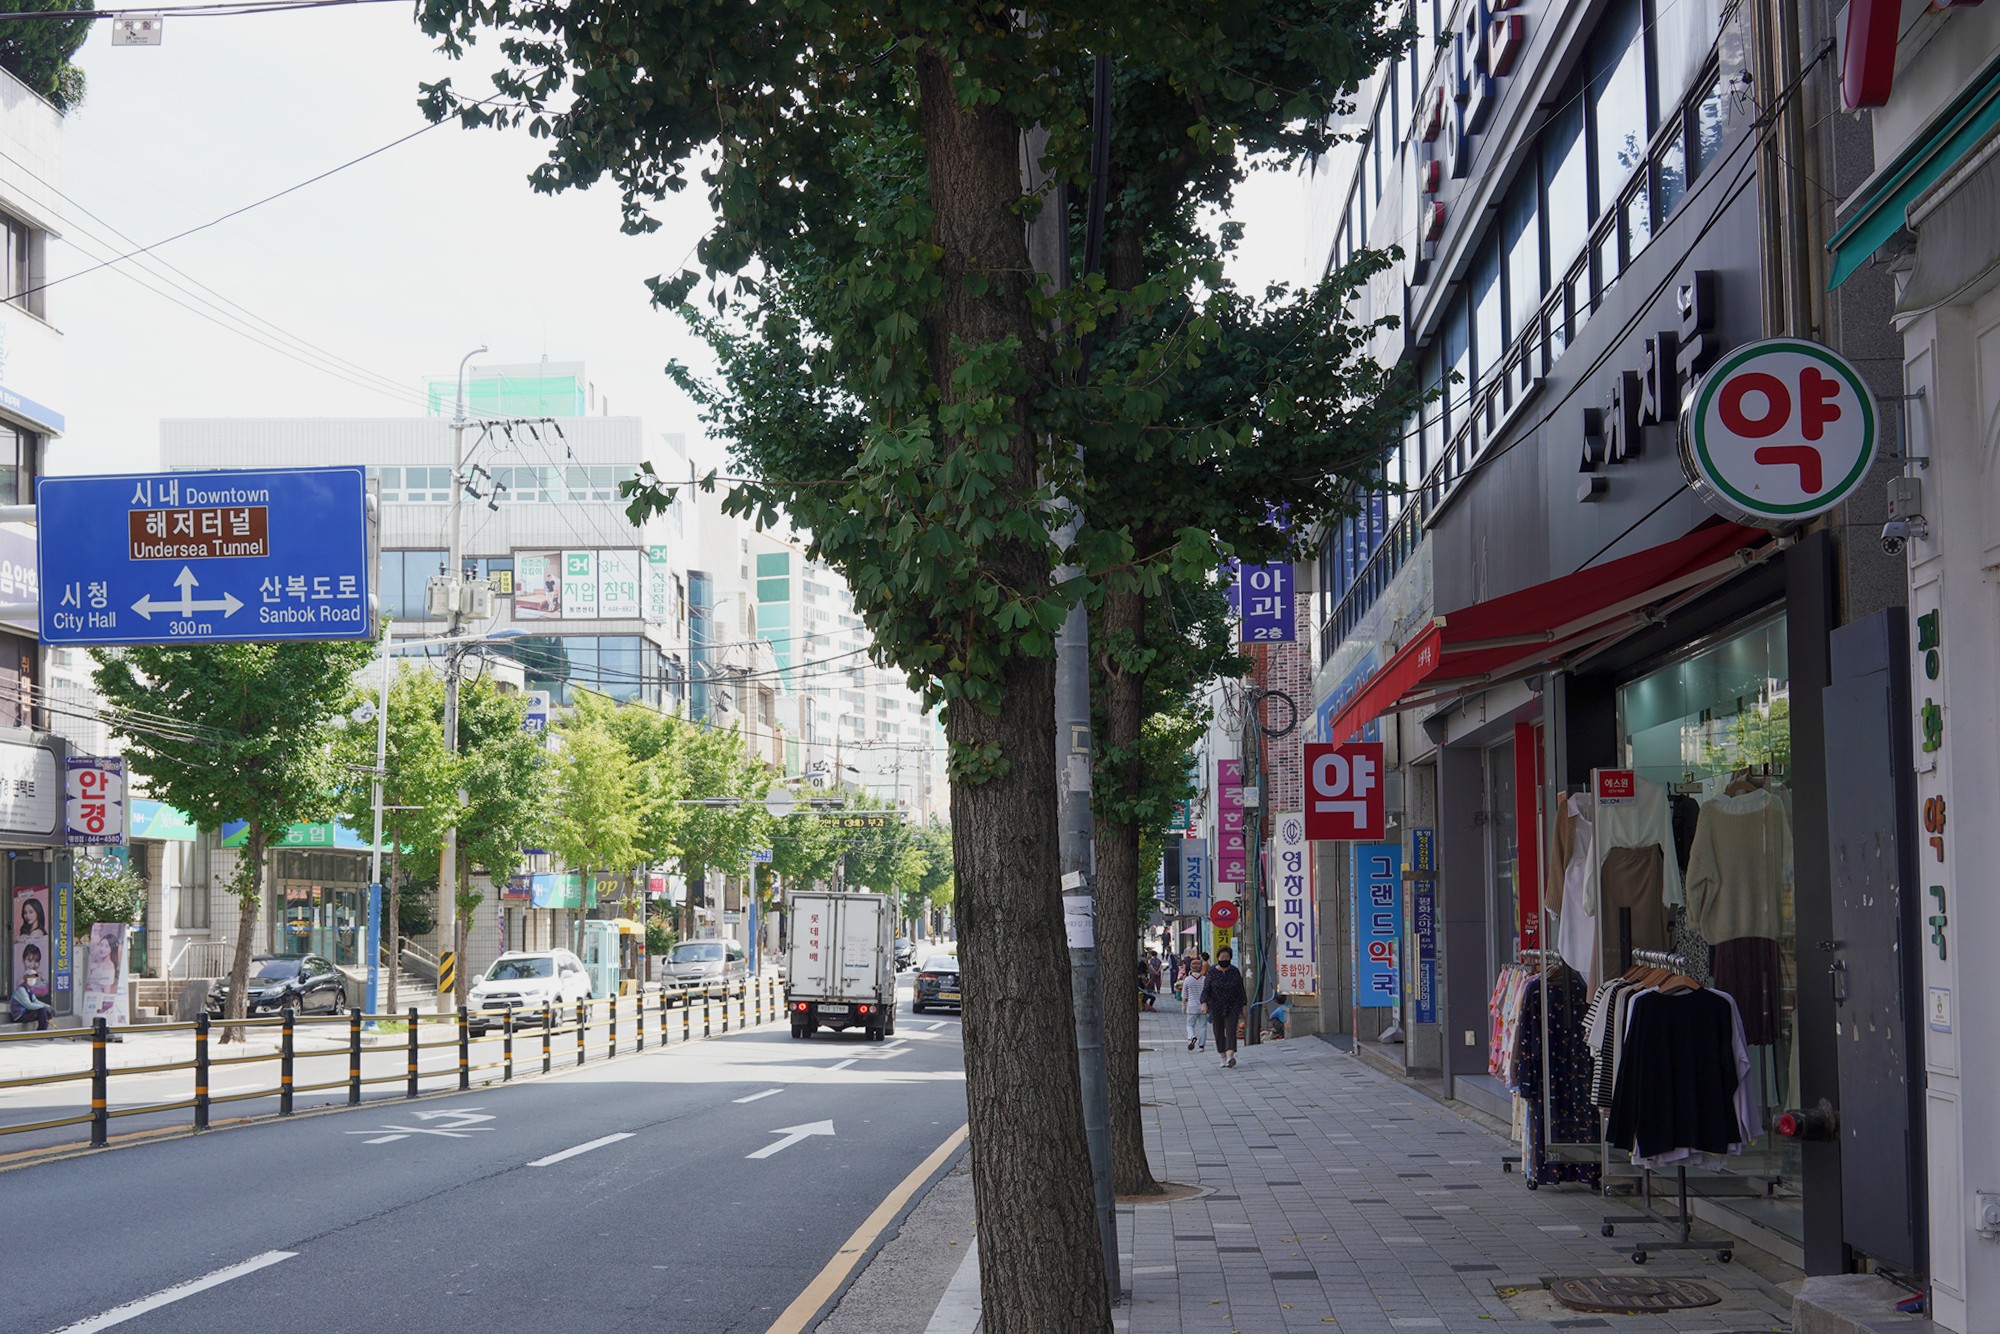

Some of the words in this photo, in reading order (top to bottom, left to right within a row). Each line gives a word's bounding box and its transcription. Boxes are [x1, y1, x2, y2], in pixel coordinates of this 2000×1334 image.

[1718, 367, 1841, 493] 약
[131, 479, 179, 506] 시내
[186, 487, 269, 506] Downtown
[146, 508, 251, 539] 해저터널
[134, 541, 208, 558] Undersea
[212, 538, 263, 556] Tunnel
[60, 580, 108, 609] 시청
[259, 575, 360, 603] 산복도로
[565, 583, 596, 602] 지압
[604, 581, 634, 602] 침대
[1249, 560, 1286, 620] 아과
[53, 613, 84, 633] City
[89, 611, 116, 629] Hall
[260, 607, 315, 624] Sanbok
[321, 604, 360, 622] Road
[1254, 627, 1283, 640] 2층
[1312, 754, 1376, 829] 약
[1604, 778, 1629, 788] 에스원
[79, 771, 109, 833] 안경
[288, 827, 326, 842] 농협
[1187, 856, 1202, 899] 박기수치과
[1282, 851, 1304, 959] 영창피아노
[1418, 897, 1432, 936] 평화소아과
[810, 914, 819, 962] 롯데택배
[1369, 857, 1394, 996] 그랜드약국
[1281, 964, 1313, 977] 종합악기
[1291, 979, 1305, 989] 4층
